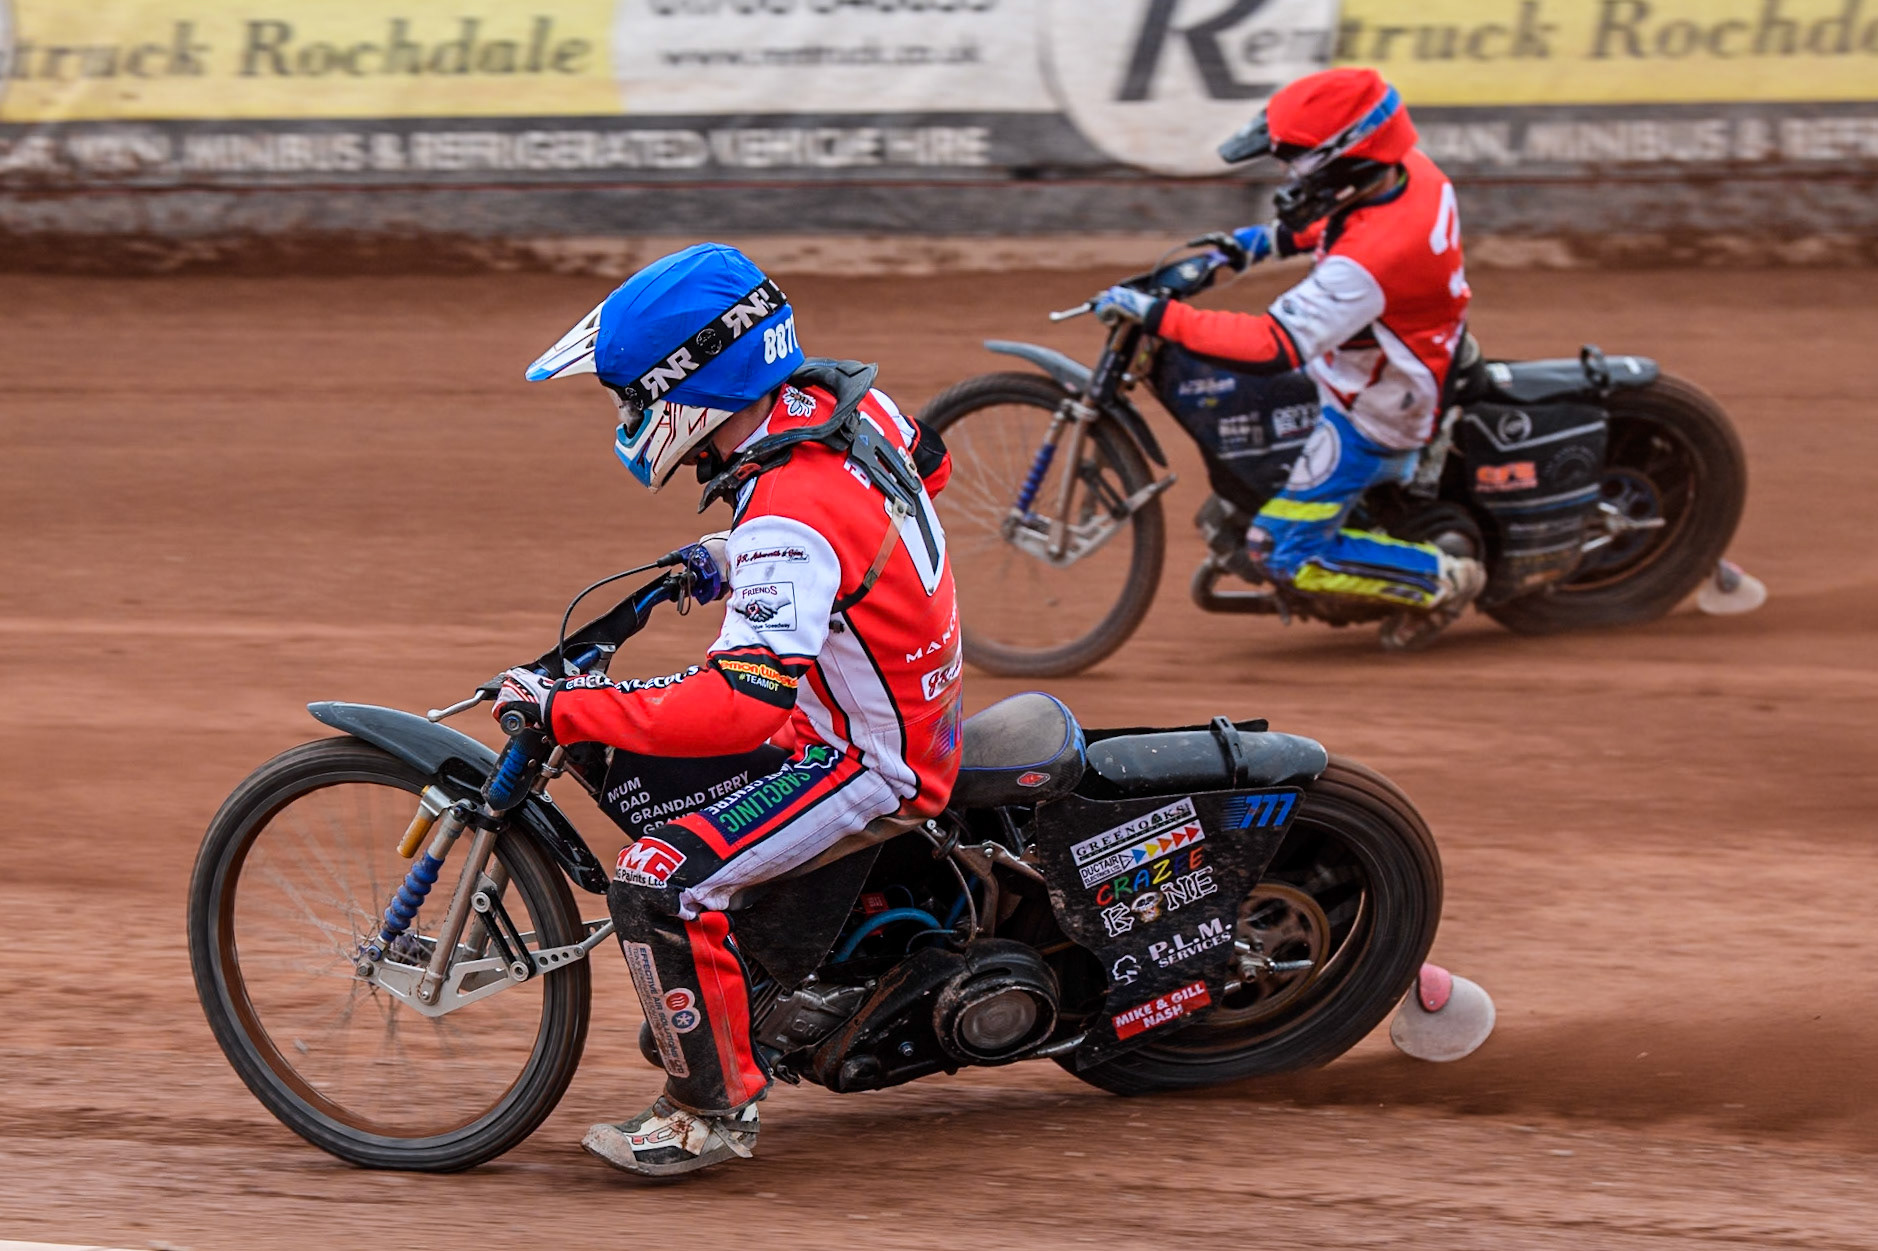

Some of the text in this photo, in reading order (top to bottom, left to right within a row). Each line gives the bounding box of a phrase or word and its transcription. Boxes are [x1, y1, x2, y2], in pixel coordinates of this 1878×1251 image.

[237, 16, 591, 78] Rochdale
[742, 585, 778, 599] FRIENDS
[718, 659, 760, 676] emon
[607, 776, 642, 803] MUM
[619, 791, 651, 813] DAD
[630, 791, 706, 825] GRANDAD
[707, 769, 750, 800] TERRY
[1240, 793, 1297, 829] 777
[621, 869, 646, 884] Paints
[1081, 855, 1120, 879] DUCTAIR
[1096, 846, 1204, 906] CRAZEE
[1148, 917, 1232, 962] P.L.M.
[1158, 931, 1232, 969] SERVICES
[1115, 983, 1206, 1028] MIKE & GILL
[1142, 1003, 1184, 1029] NASH
